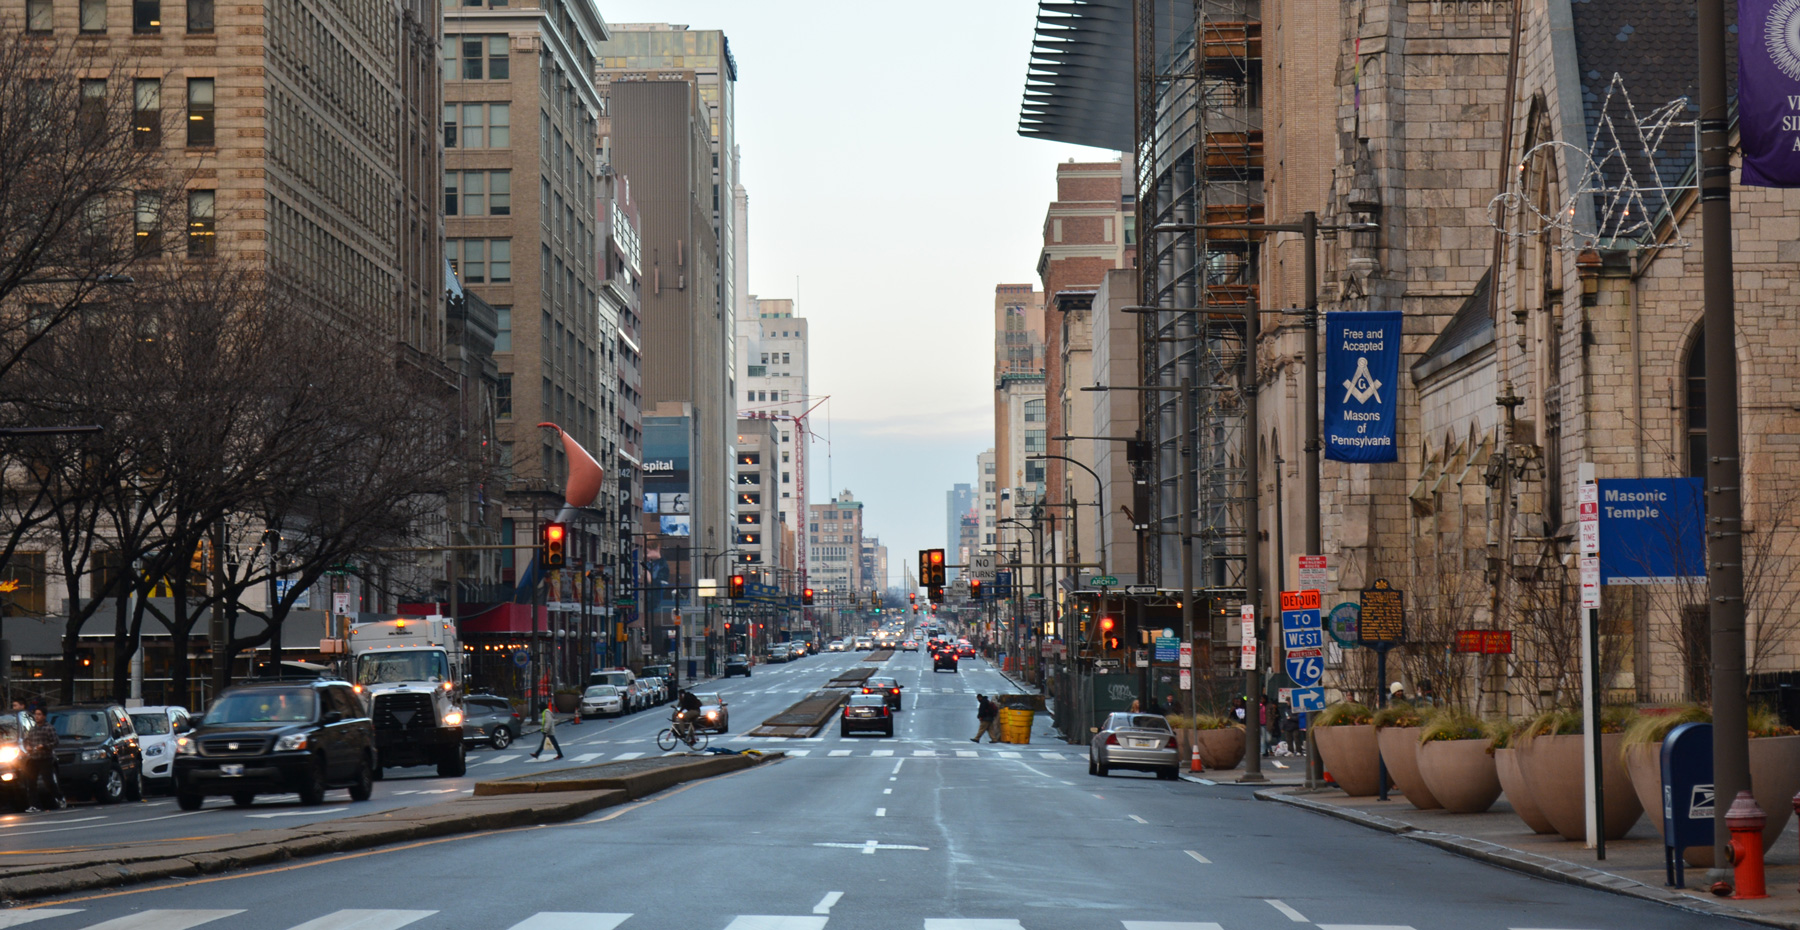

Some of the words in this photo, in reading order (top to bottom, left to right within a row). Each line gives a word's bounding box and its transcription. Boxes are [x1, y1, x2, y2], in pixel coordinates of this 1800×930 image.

[1343, 328, 1363, 339] Free
[1366, 328, 1383, 339] and
[1342, 340, 1383, 353] Accepted
[1358, 378, 1367, 390] G
[1344, 410, 1380, 421] Masons
[1357, 422, 1367, 434] of
[1331, 434, 1391, 448] Pennsylvania
[641, 459, 674, 473] spital
[618, 468, 631, 478] 142
[1604, 489, 1667, 502] Masonic
[1584, 503, 1593, 514] NO
[1604, 506, 1660, 520] Temple
[1584, 524, 1595, 532] ANY
[1583, 533, 1596, 542] TIME
[975, 559, 989, 567] NO
[971, 570, 996, 578] TURNS
[1283, 594, 1318, 606] DETOUR
[1292, 614, 1311, 625] TO
[1288, 633, 1318, 645] WEST
[1290, 658, 1321, 680] 76
